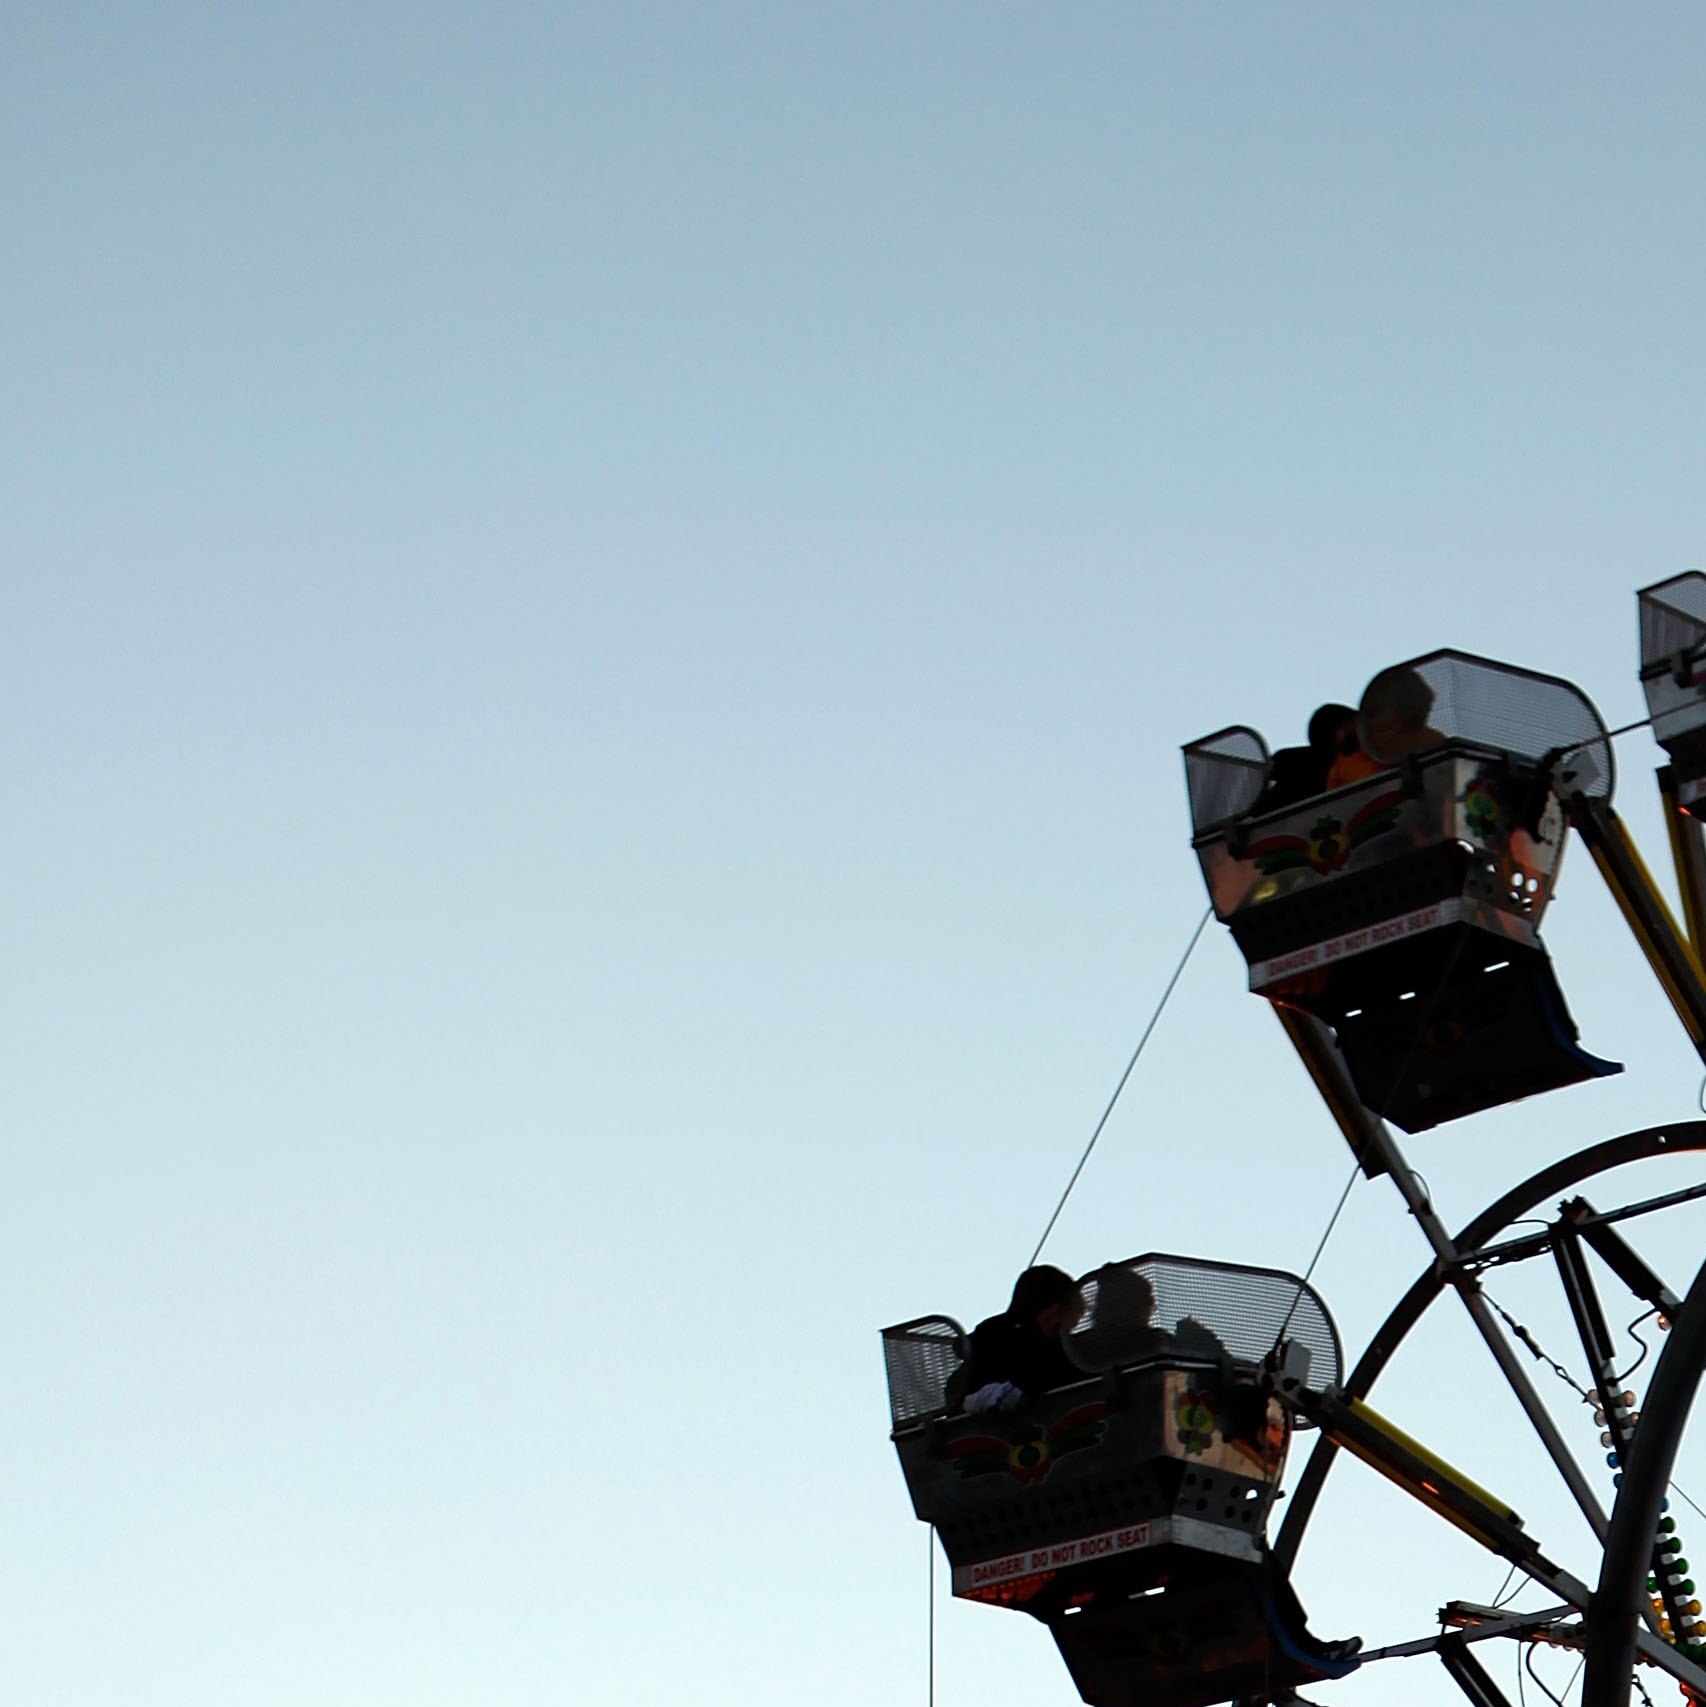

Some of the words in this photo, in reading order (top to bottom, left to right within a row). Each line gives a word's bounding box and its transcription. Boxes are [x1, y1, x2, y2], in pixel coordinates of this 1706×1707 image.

[1344, 933, 1369, 950] NOT
[1372, 921, 1405, 942] ROCK
[1408, 909, 1438, 928] SEAT
[973, 1556, 1025, 1582] DANGER!
[1031, 1552, 1049, 1568] DO
[1052, 1544, 1076, 1562] NOT
[1080, 1536, 1113, 1557] ROCK
[1118, 1526, 1147, 1548] SEAT
